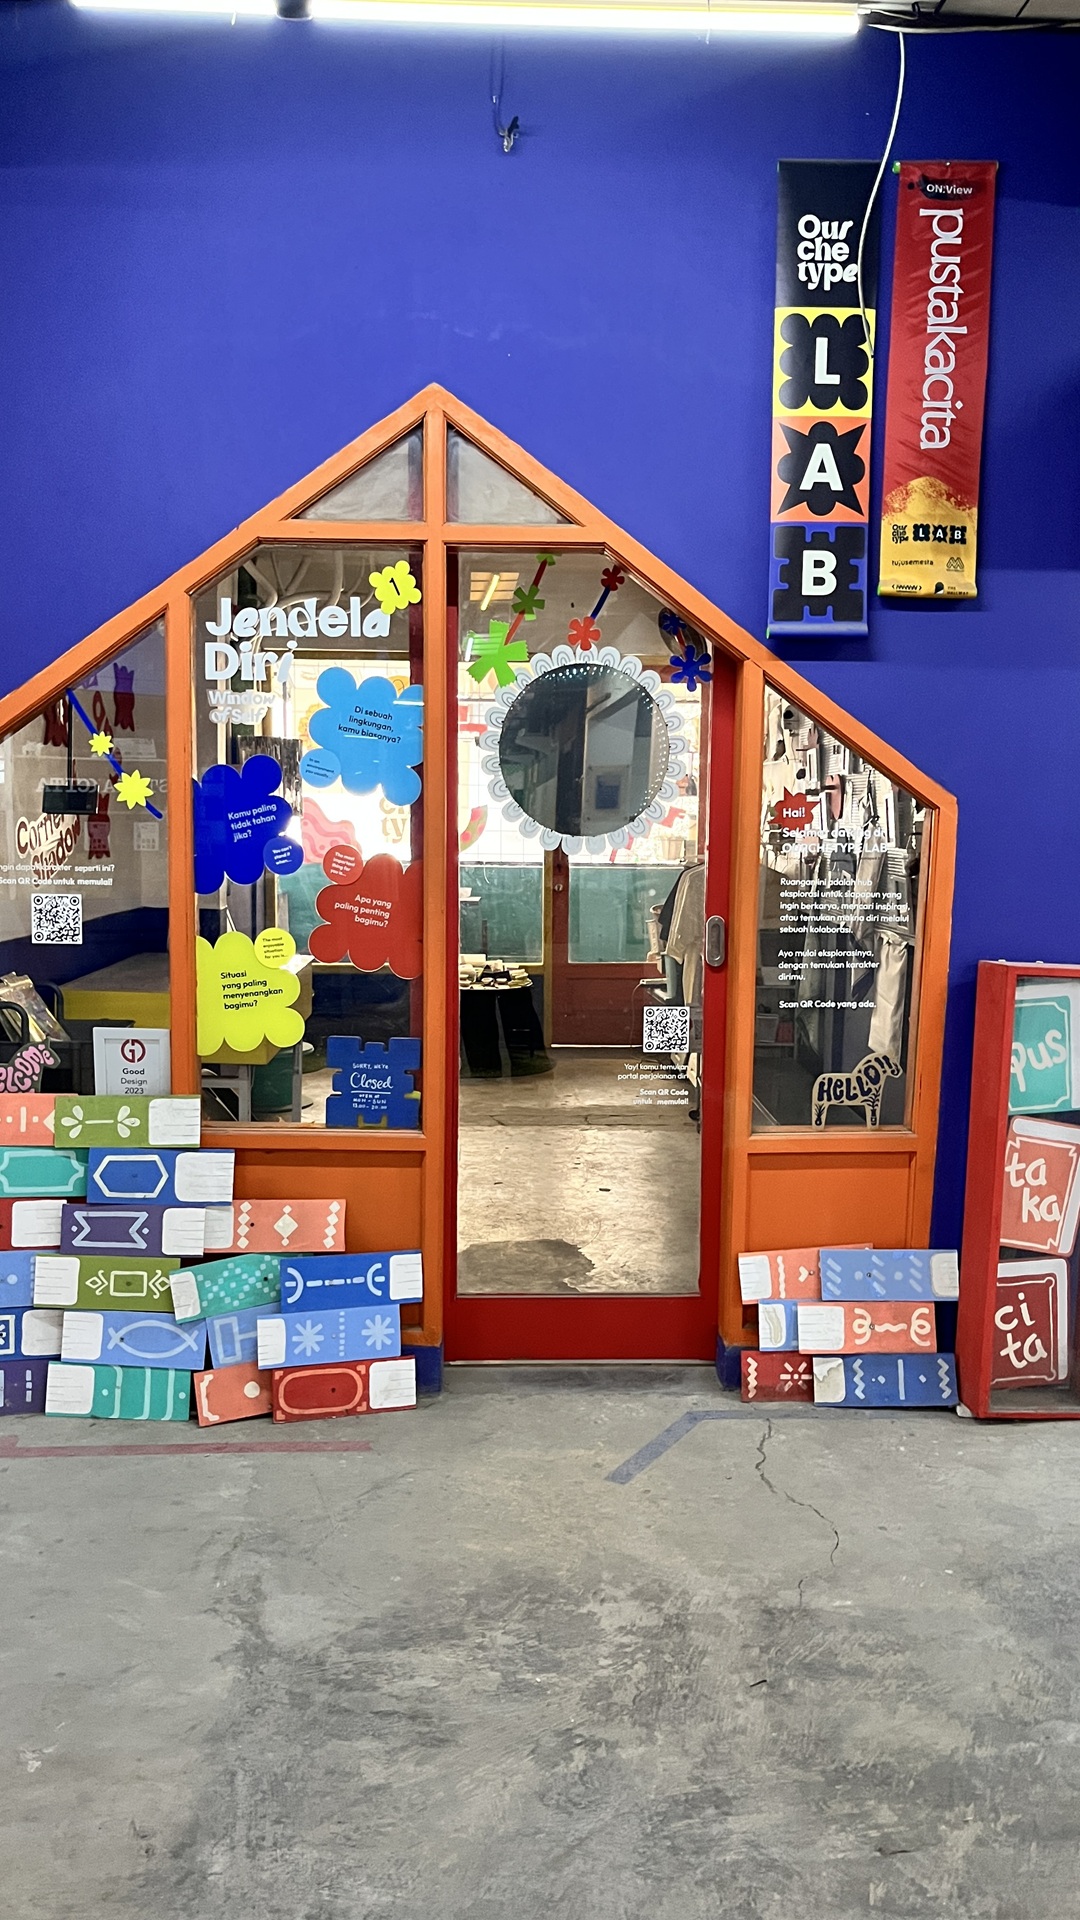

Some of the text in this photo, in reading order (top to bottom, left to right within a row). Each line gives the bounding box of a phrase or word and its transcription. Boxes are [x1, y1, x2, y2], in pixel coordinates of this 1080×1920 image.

[926, 184, 973, 195] ON:View
[797, 214, 853, 240] Our
[797, 237, 850, 261] che
[797, 262, 858, 291] type
[919, 208, 968, 450] pustakacita
[814, 337, 840, 384] L
[799, 443, 843, 491] A
[801, 550, 837, 595] B
[389, 577, 400, 596] 1
[205, 597, 391, 637] Jendela
[205, 641, 298, 683] Diri
[208, 690, 275, 705] Window
[211, 707, 232, 722] of
[232, 708, 265, 722] Self
[354, 706, 393, 720] Di sebuah
[349, 715, 394, 732] lingkungan,
[338, 724, 401, 743] kamu biasanya?
[228, 804, 277, 820] Kamu paling
[783, 807, 806, 818] Hai!
[231, 815, 276, 830] tidak tahan
[233, 830, 252, 842] jika?
[782, 828, 829, 838] Selamat
[865, 843, 888, 853] LAB
[74, 864, 101, 873] seperti
[102, 864, 115, 872] ini?
[18, 877, 31, 885] QR
[77, 878, 113, 886] memulai!
[780, 878, 814, 887] Ruangan
[355, 894, 392, 909] Apa yang
[780, 890, 902, 899] eksplorasi untuk siapapun yang
[334, 902, 390, 919] paling penting
[780, 902, 910, 911] ingin berkarya, mencari inspirasi,
[354, 915, 388, 928] bagimu?
[837, 914, 864, 922] makna
[866, 914, 879, 922] diri
[881, 914, 909, 922] melalui
[778, 949, 874, 958] Ayo mulai eksplorasinya,
[778, 961, 880, 970] dengan temukan karakter
[220, 970, 247, 979] Situasi
[778, 973, 806, 981] dirimu.
[222, 979, 267, 990] yang paling
[223, 988, 283, 999] menyenangkan
[224, 1000, 258, 1010] bagimu?
[624, 1063, 639, 1071] Yay!
[1011, 1029, 1067, 1093] pus
[120, 1077, 148, 1085] Design
[350, 1072, 394, 1090] Closed
[1004, 1152, 1047, 1187] ta
[1022, 1187, 1061, 1223] ka
[994, 1292, 1035, 1330] ci
[1000, 1333, 1048, 1368] ta
